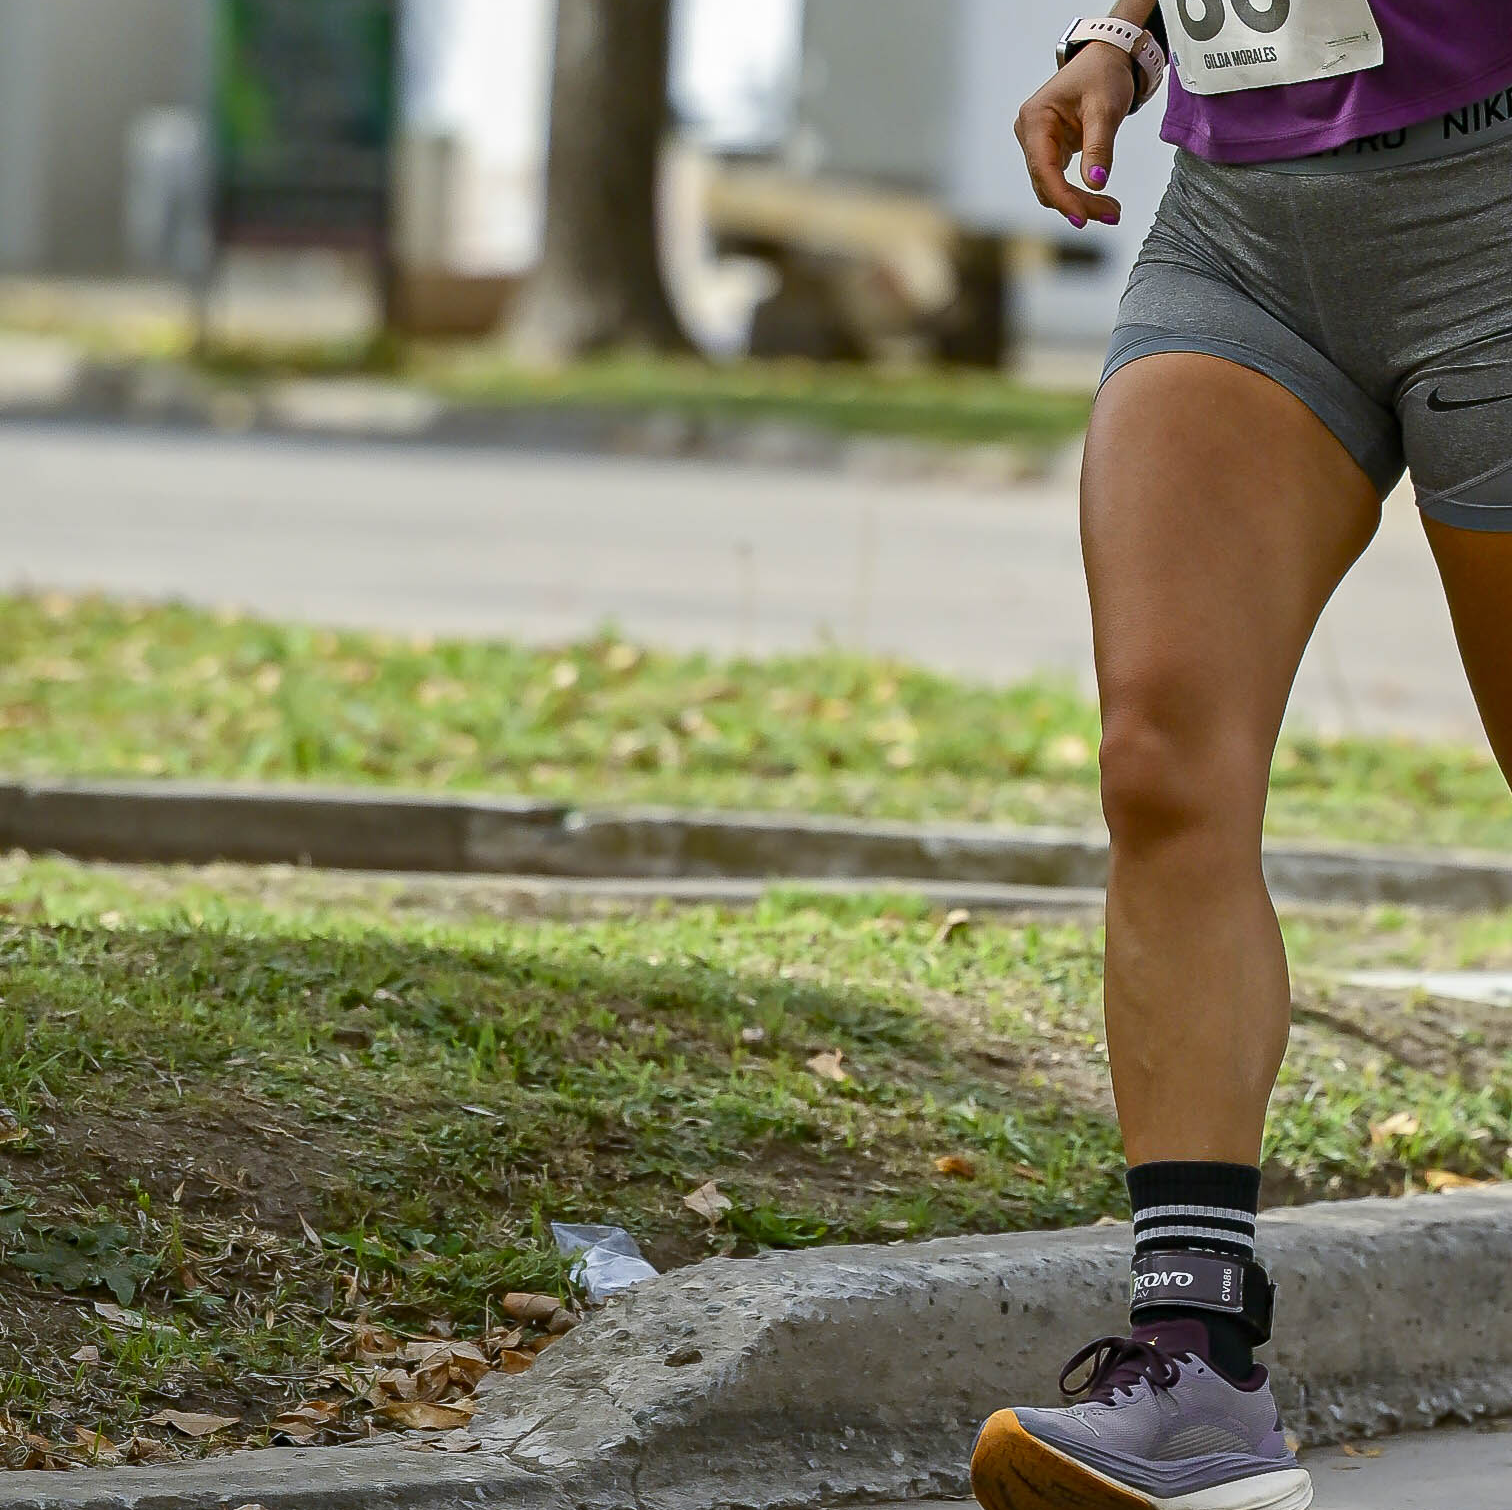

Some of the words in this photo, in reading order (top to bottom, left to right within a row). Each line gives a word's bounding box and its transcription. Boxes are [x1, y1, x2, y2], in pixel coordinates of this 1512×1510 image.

[1203, 51, 1232, 70] GILDA
[1231, 46, 1278, 68] MORALES
[1221, 1268, 1233, 1302] CV086
